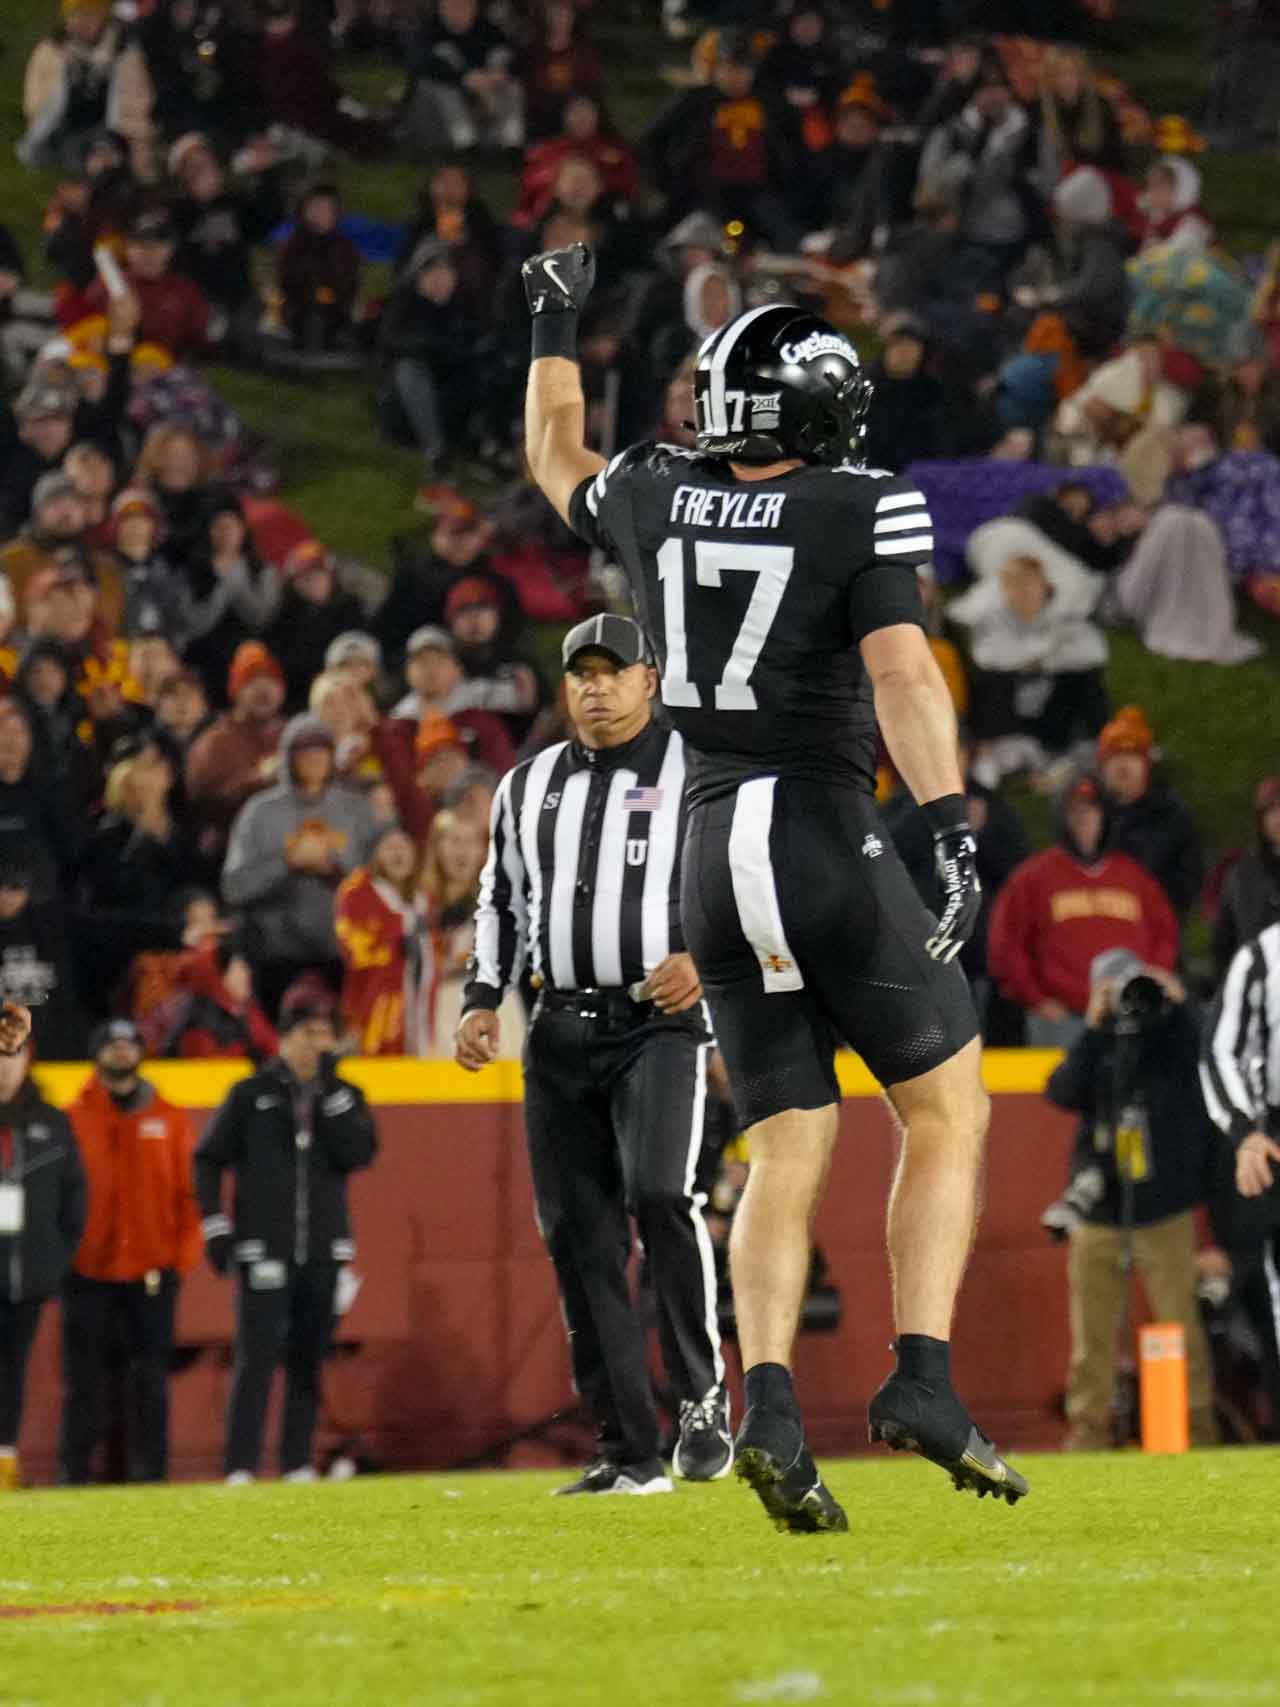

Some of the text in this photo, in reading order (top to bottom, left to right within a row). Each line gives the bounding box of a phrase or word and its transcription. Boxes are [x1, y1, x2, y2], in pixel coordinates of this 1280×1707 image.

[669, 485, 787, 529] FREYLER
[655, 537, 795, 711] 17
[542, 792, 561, 810] S
[626, 839, 648, 866] U
[943, 859, 962, 894] IOWA
